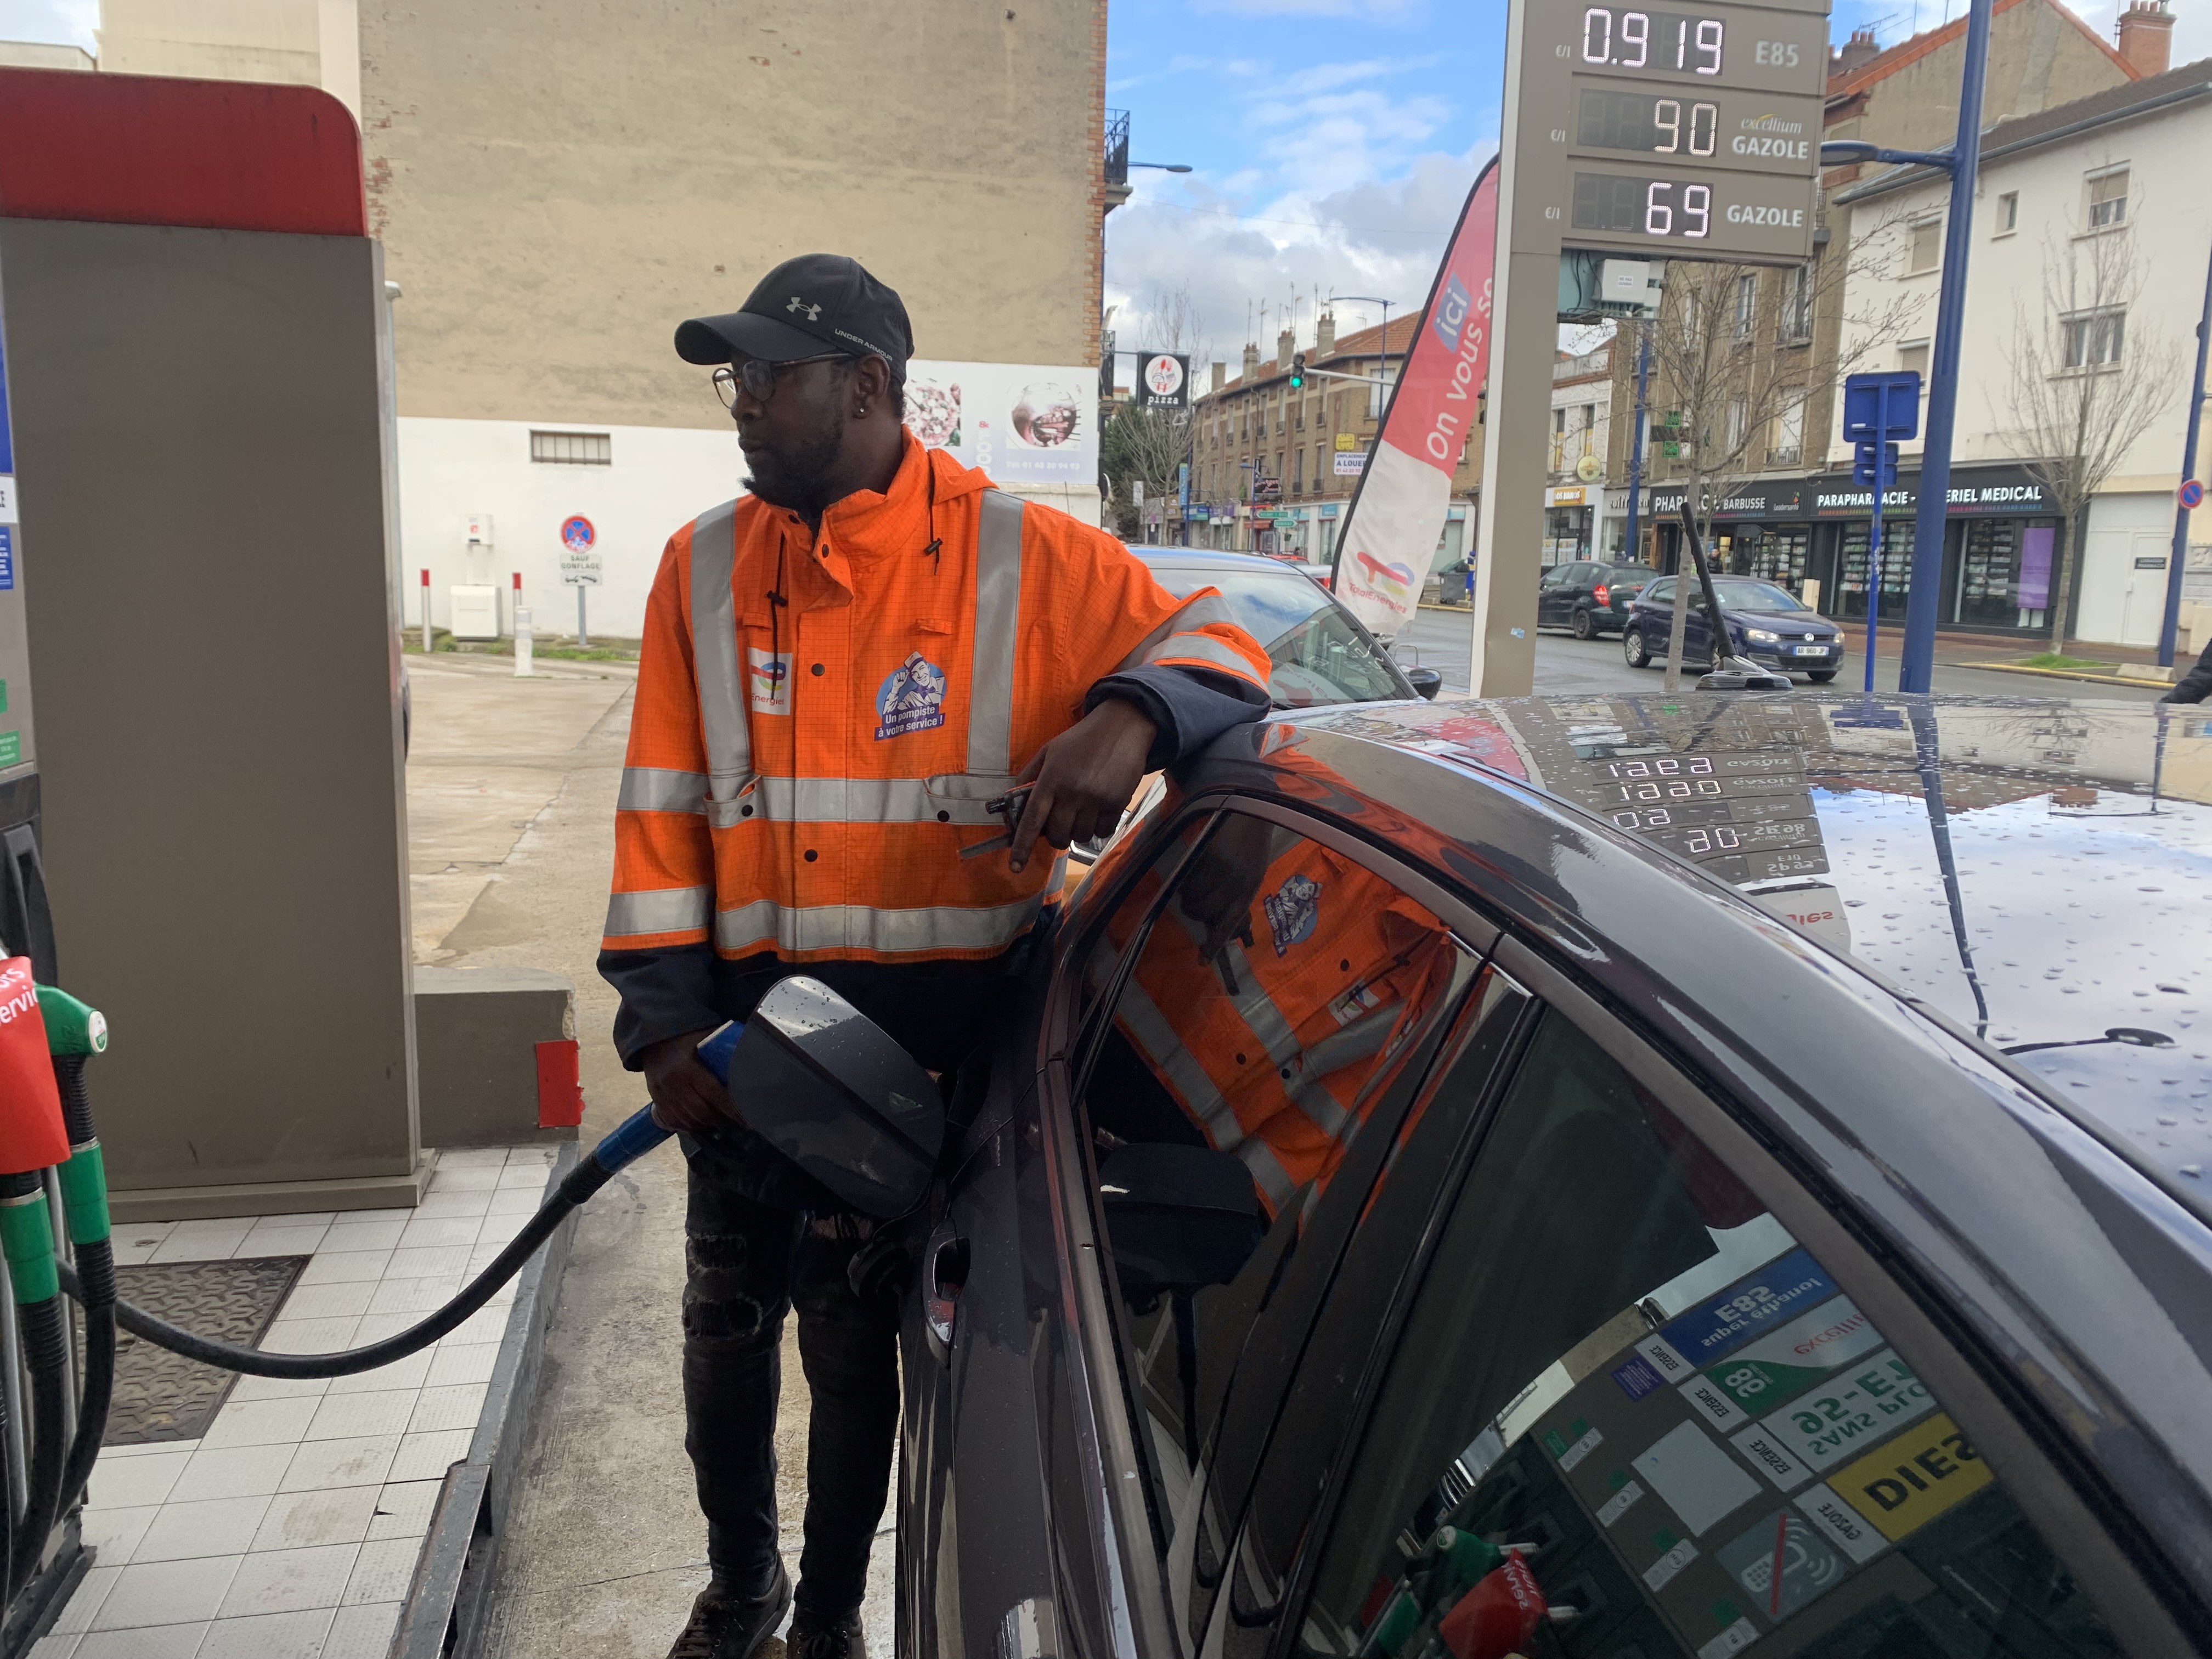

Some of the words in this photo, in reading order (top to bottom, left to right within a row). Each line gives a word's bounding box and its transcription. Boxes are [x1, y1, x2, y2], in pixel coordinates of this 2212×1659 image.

[1583, 8, 1723, 74] 0.919
[1756, 40, 1799, 67] E85
[1654, 99, 1717, 156] 90
[1741, 114, 1802, 134] excellium
[1733, 135, 1809, 159] GAZOLE
[1646, 182, 1710, 237] 69
[1727, 205, 1803, 228] GAZOLE
[1437, 287, 1468, 337] ici
[835, 328, 864, 345] UNDER
[864, 341, 893, 362] ARMOUR
[1426, 411, 1459, 460] On
[1446, 322, 1483, 400] vous
[1478, 277, 1492, 320] so
[1147, 394, 1179, 405] pizza
[1724, 497, 1766, 510] BARBUSSE
[1817, 492, 1908, 507] PARAPHARACIE
[1981, 485, 2042, 503] MEDICAL
[1349, 582, 1408, 614] TotalEnergies
[878, 727, 884, 738] à
[885, 724, 905, 737] votre
[905, 717, 938, 731] service
[939, 716, 944, 725] !
[885, 714, 897, 725] Un
[898, 705, 936, 724] pompiste
[0, 988, 38, 1024] ervi
